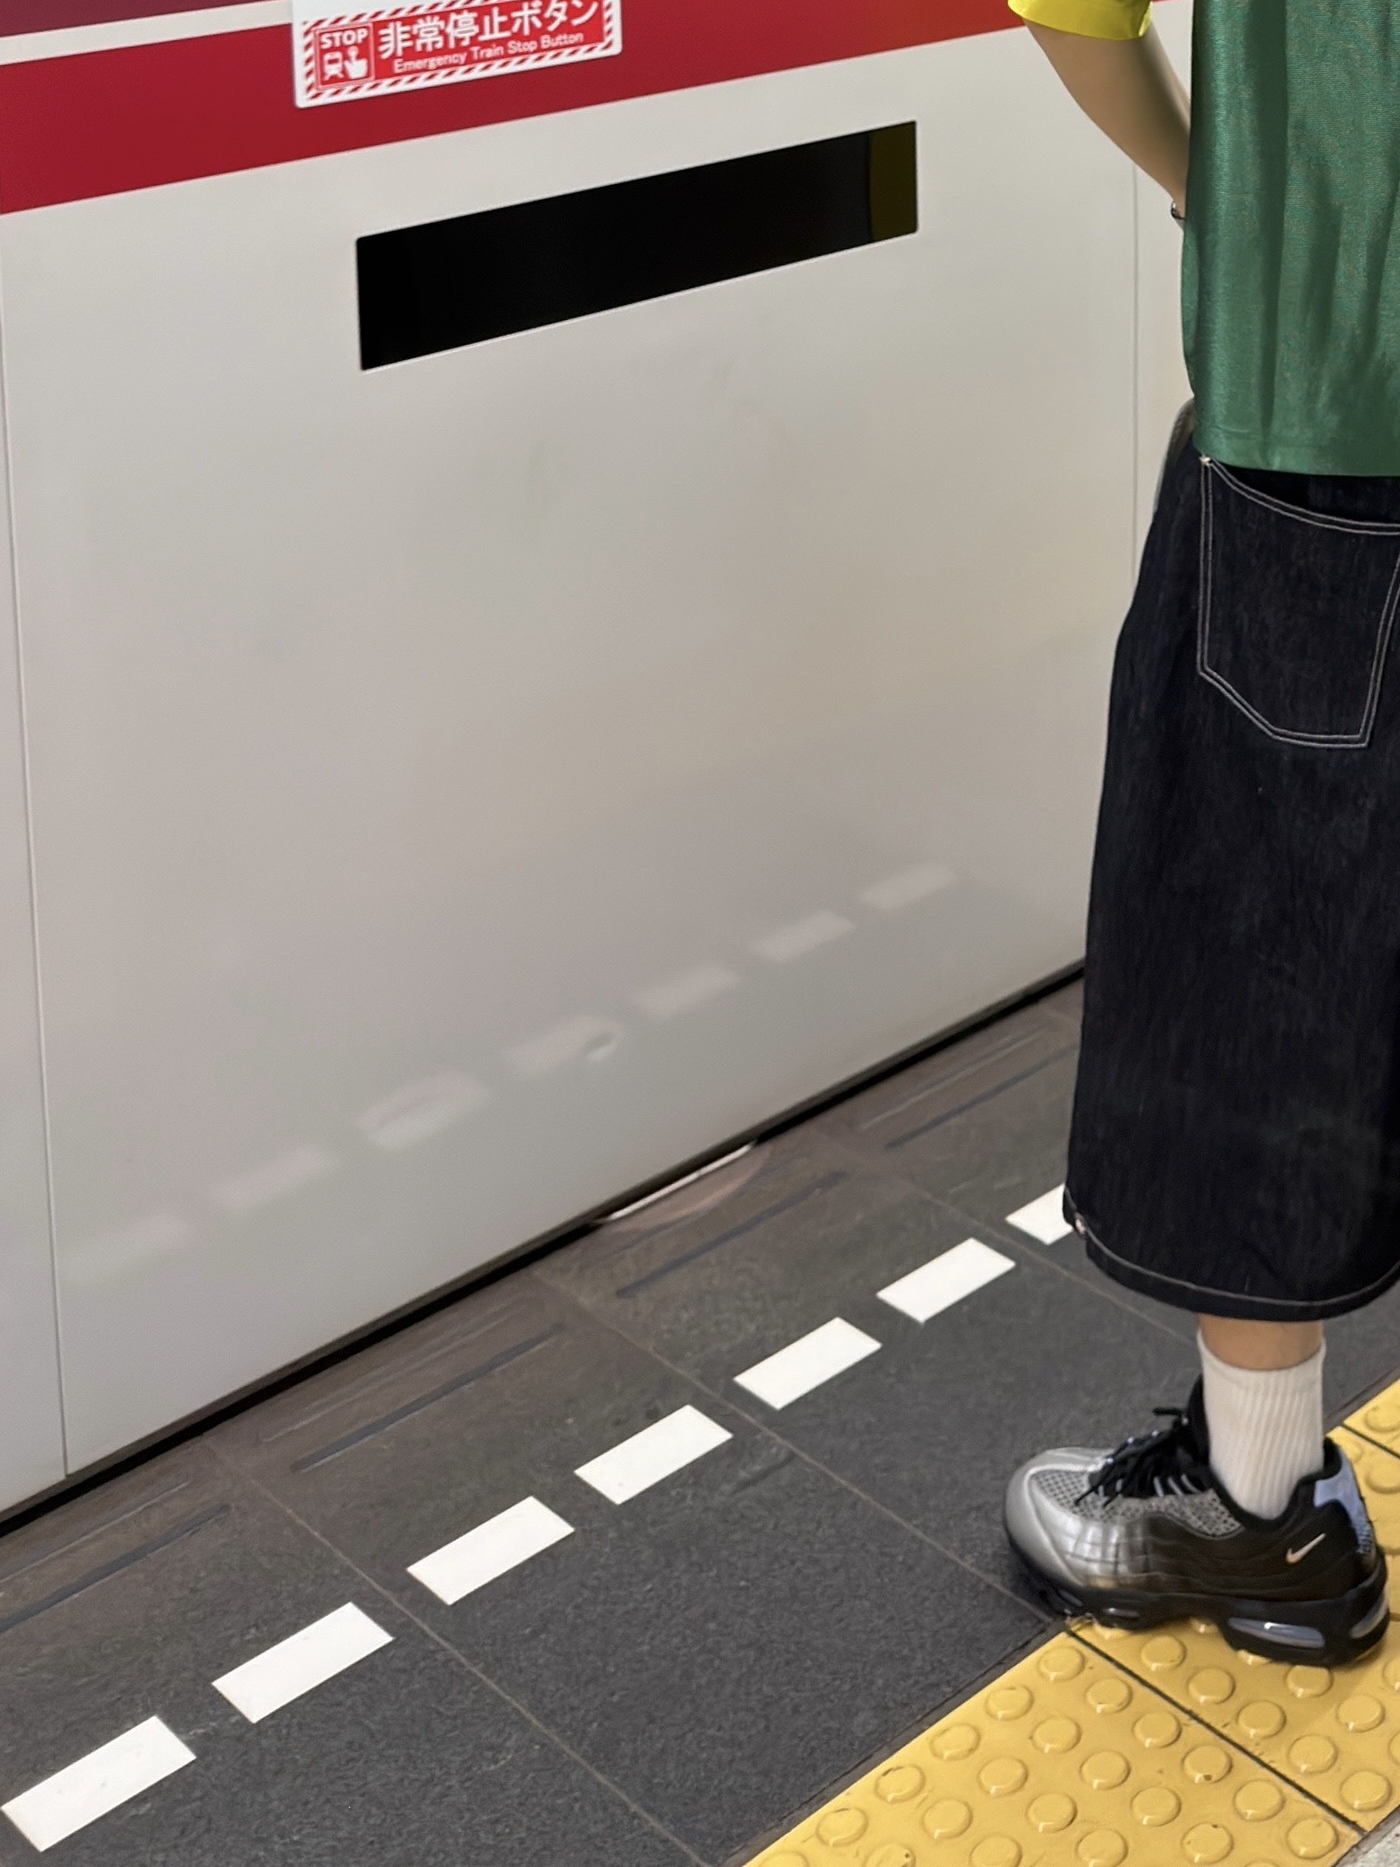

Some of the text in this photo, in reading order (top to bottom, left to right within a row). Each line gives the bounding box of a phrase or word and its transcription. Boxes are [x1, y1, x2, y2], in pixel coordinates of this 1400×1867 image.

[320, 27, 369, 49] STOP
[393, 31, 584, 74] Emergency Train Stop Button
